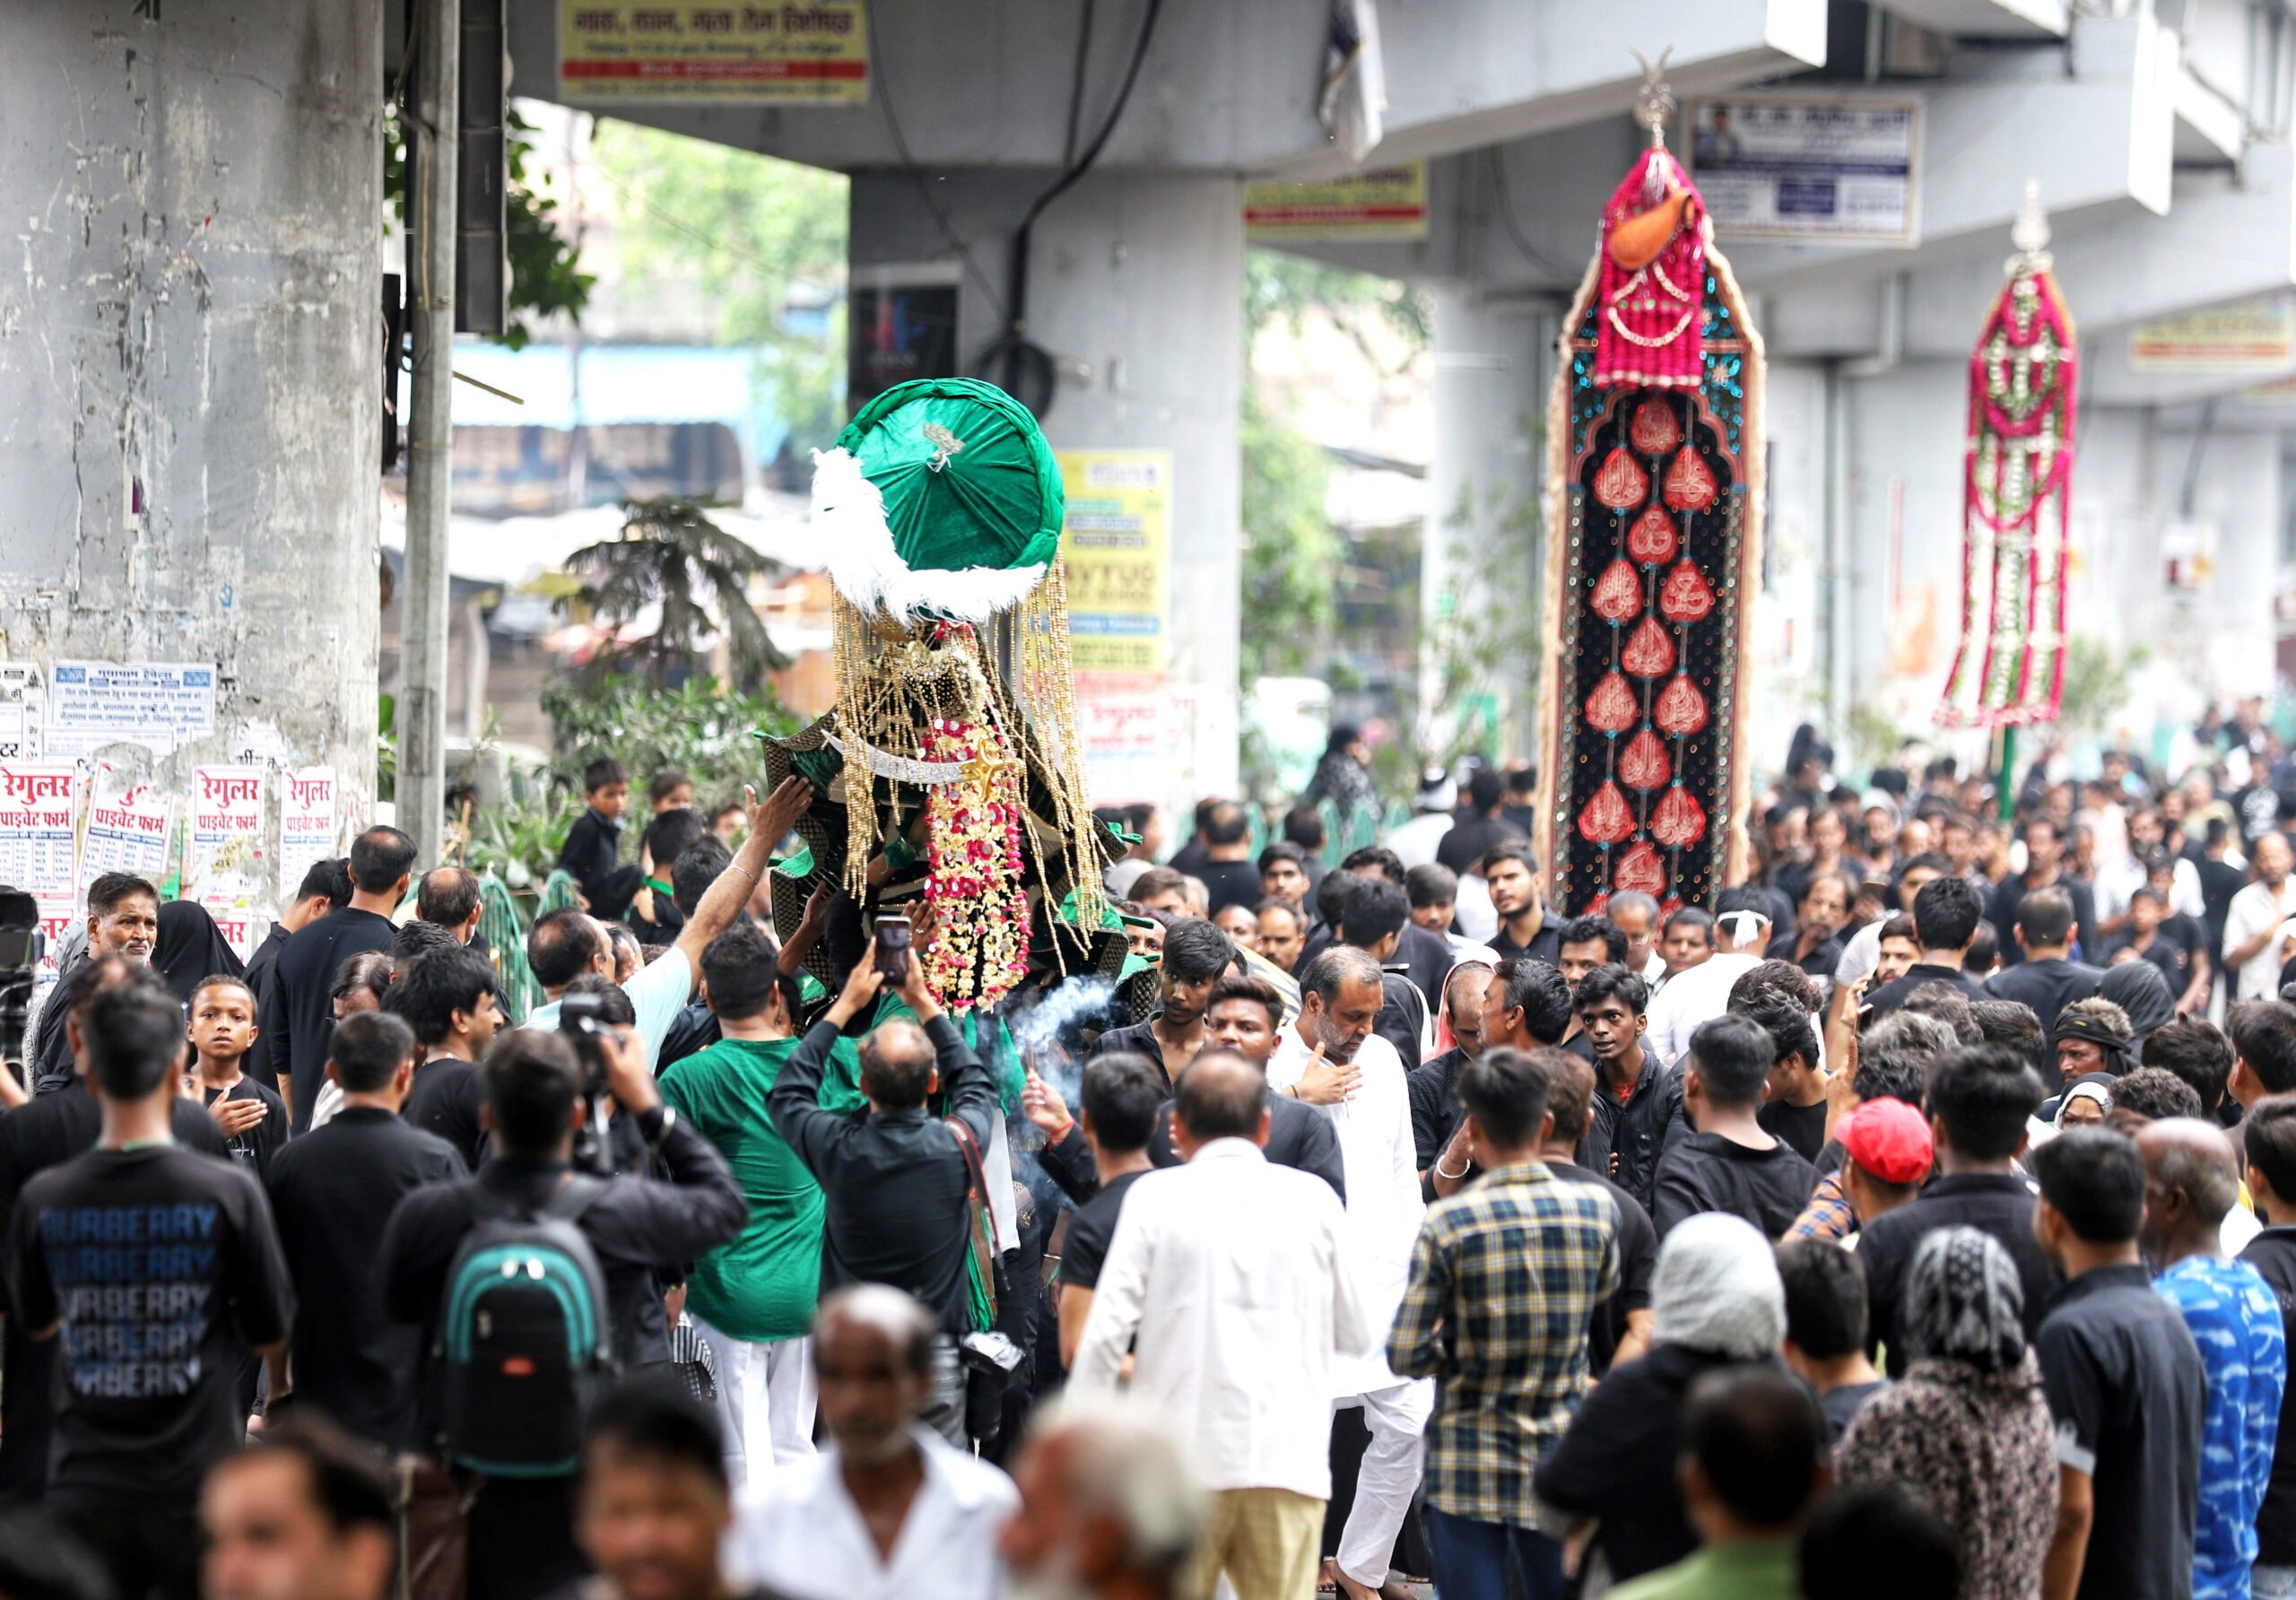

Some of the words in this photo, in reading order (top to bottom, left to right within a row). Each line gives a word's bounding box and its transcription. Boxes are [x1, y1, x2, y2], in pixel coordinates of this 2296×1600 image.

[0, 768, 72, 804] रेगुलर
[197, 770, 260, 809] रेगुलर
[286, 772, 332, 810] रेगुलर
[43, 809, 70, 827] फार्म
[138, 814, 166, 833] फार्म
[236, 813, 257, 830] फार्म
[315, 814, 331, 831] फार्म
